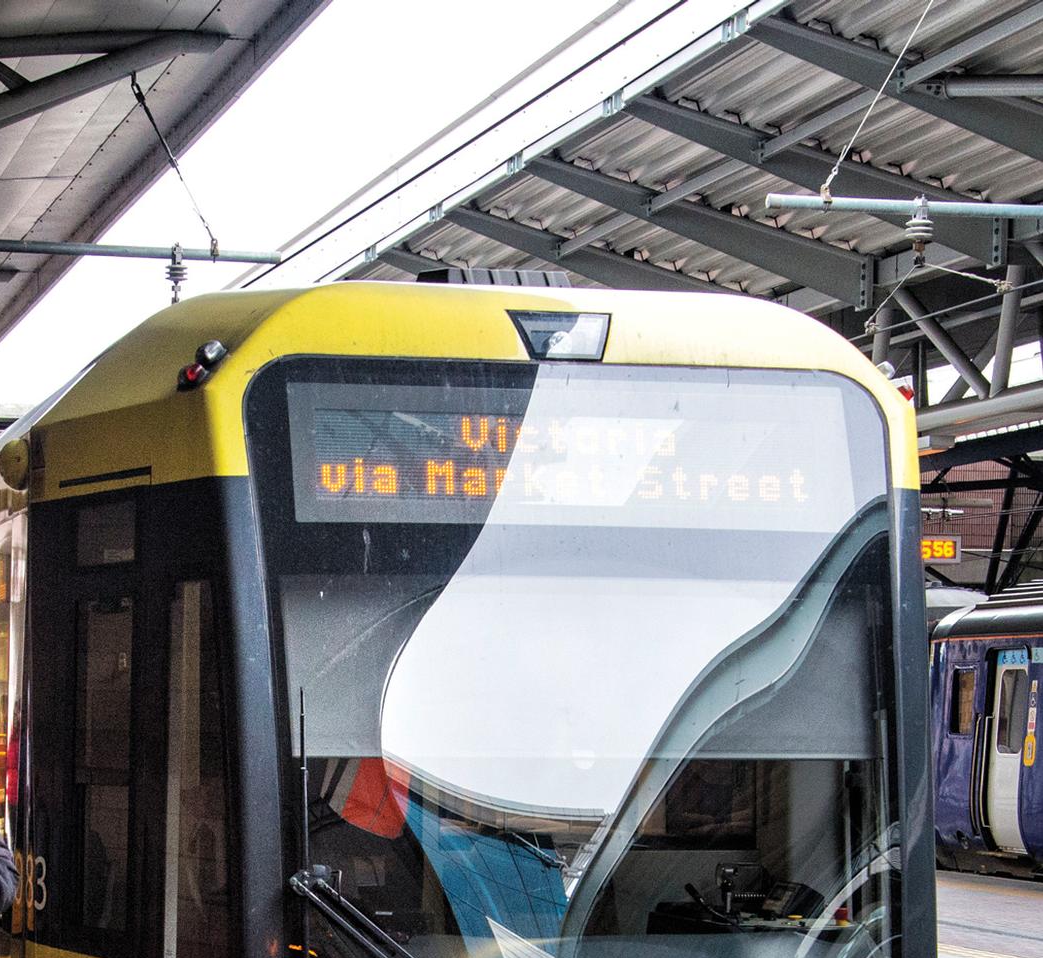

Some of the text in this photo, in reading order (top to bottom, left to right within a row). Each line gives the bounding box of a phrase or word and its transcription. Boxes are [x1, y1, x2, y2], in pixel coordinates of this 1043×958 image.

[461, 416, 676, 457] Victoria
[321, 458, 809, 503] via Market Street
